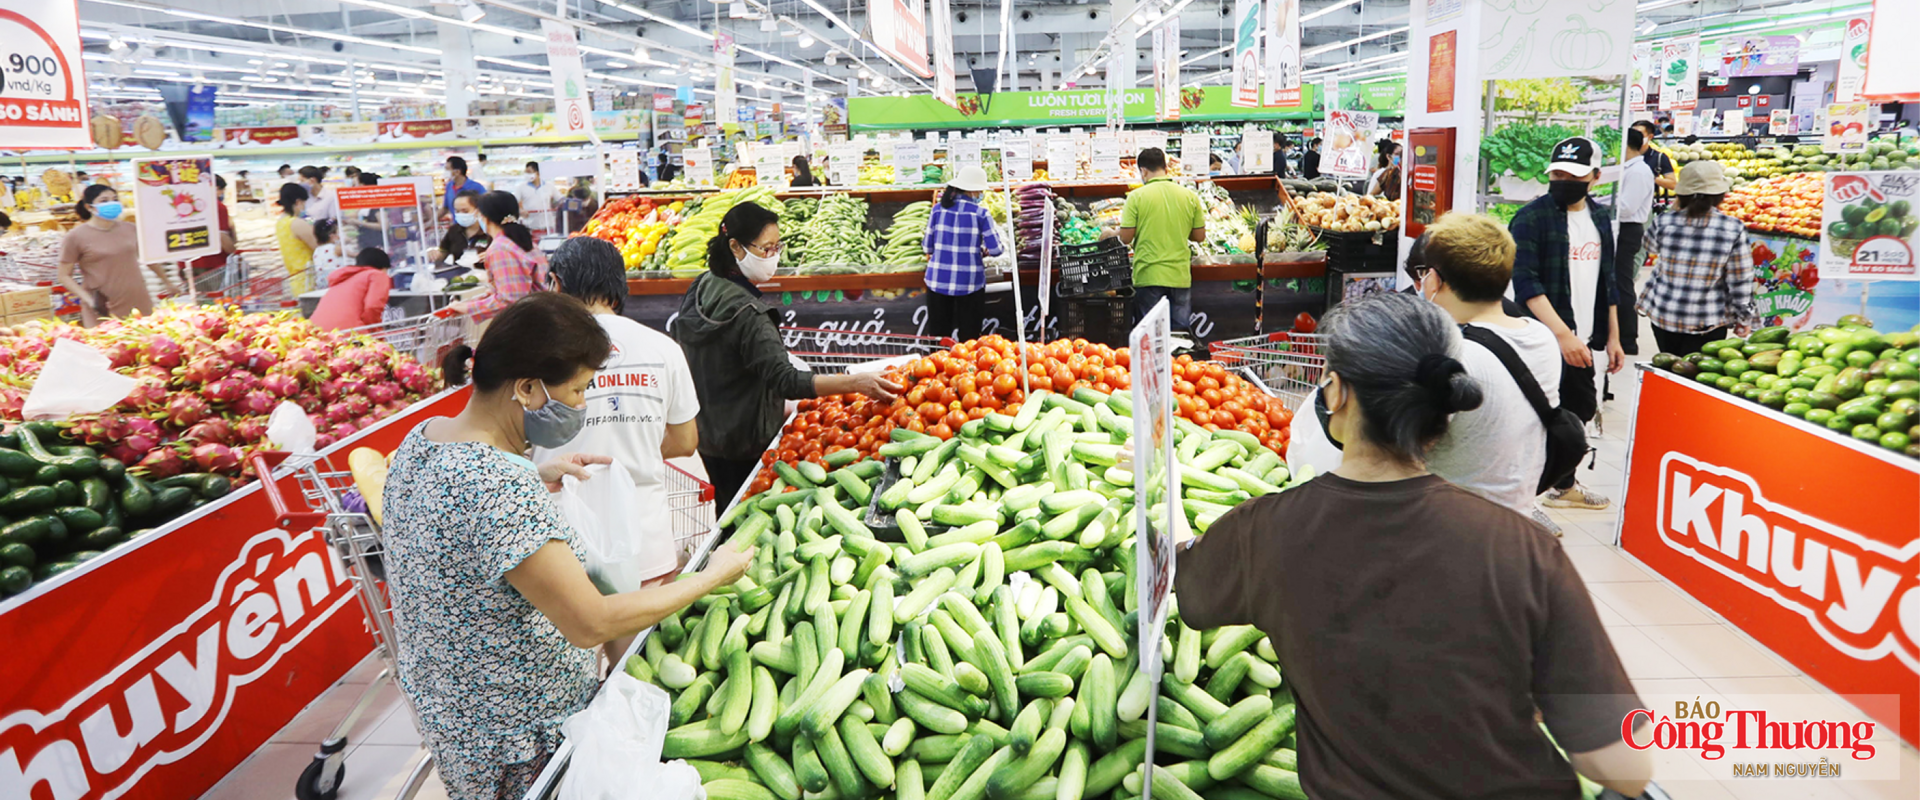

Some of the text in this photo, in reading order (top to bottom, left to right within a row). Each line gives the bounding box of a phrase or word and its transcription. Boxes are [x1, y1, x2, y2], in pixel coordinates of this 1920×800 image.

[7, 78, 52, 95] vnd/Kg
[1029, 93, 1067, 107] LUÔN
[1069, 93, 1101, 106] TƯƠI
[25, 102, 80, 122] SÁNH
[1049, 107, 1119, 117] FRESH EVERYA
[1774, 291, 1811, 313] KHẨU
[815, 308, 892, 353] quả
[597, 373, 649, 388] ONLINE
